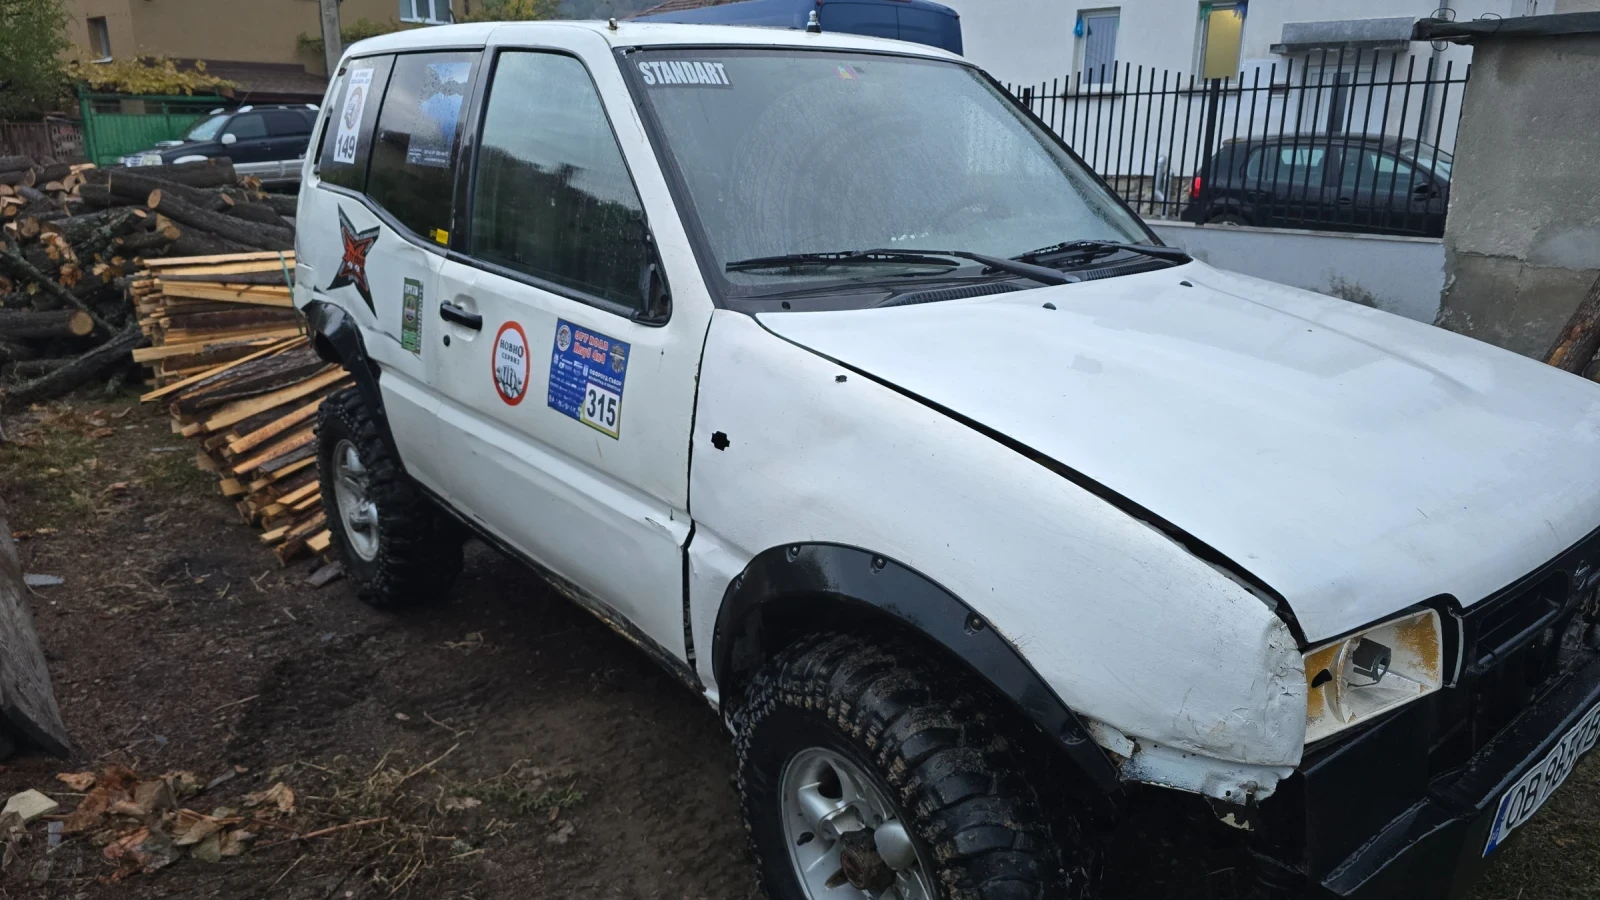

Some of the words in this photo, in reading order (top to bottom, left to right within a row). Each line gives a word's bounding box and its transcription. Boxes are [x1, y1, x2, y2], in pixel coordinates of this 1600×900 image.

[638, 61, 730, 85] STANDART
[337, 135, 355, 159] 149
[501, 352, 520, 366] СЕРВИЗ
[586, 388, 617, 427] 315
